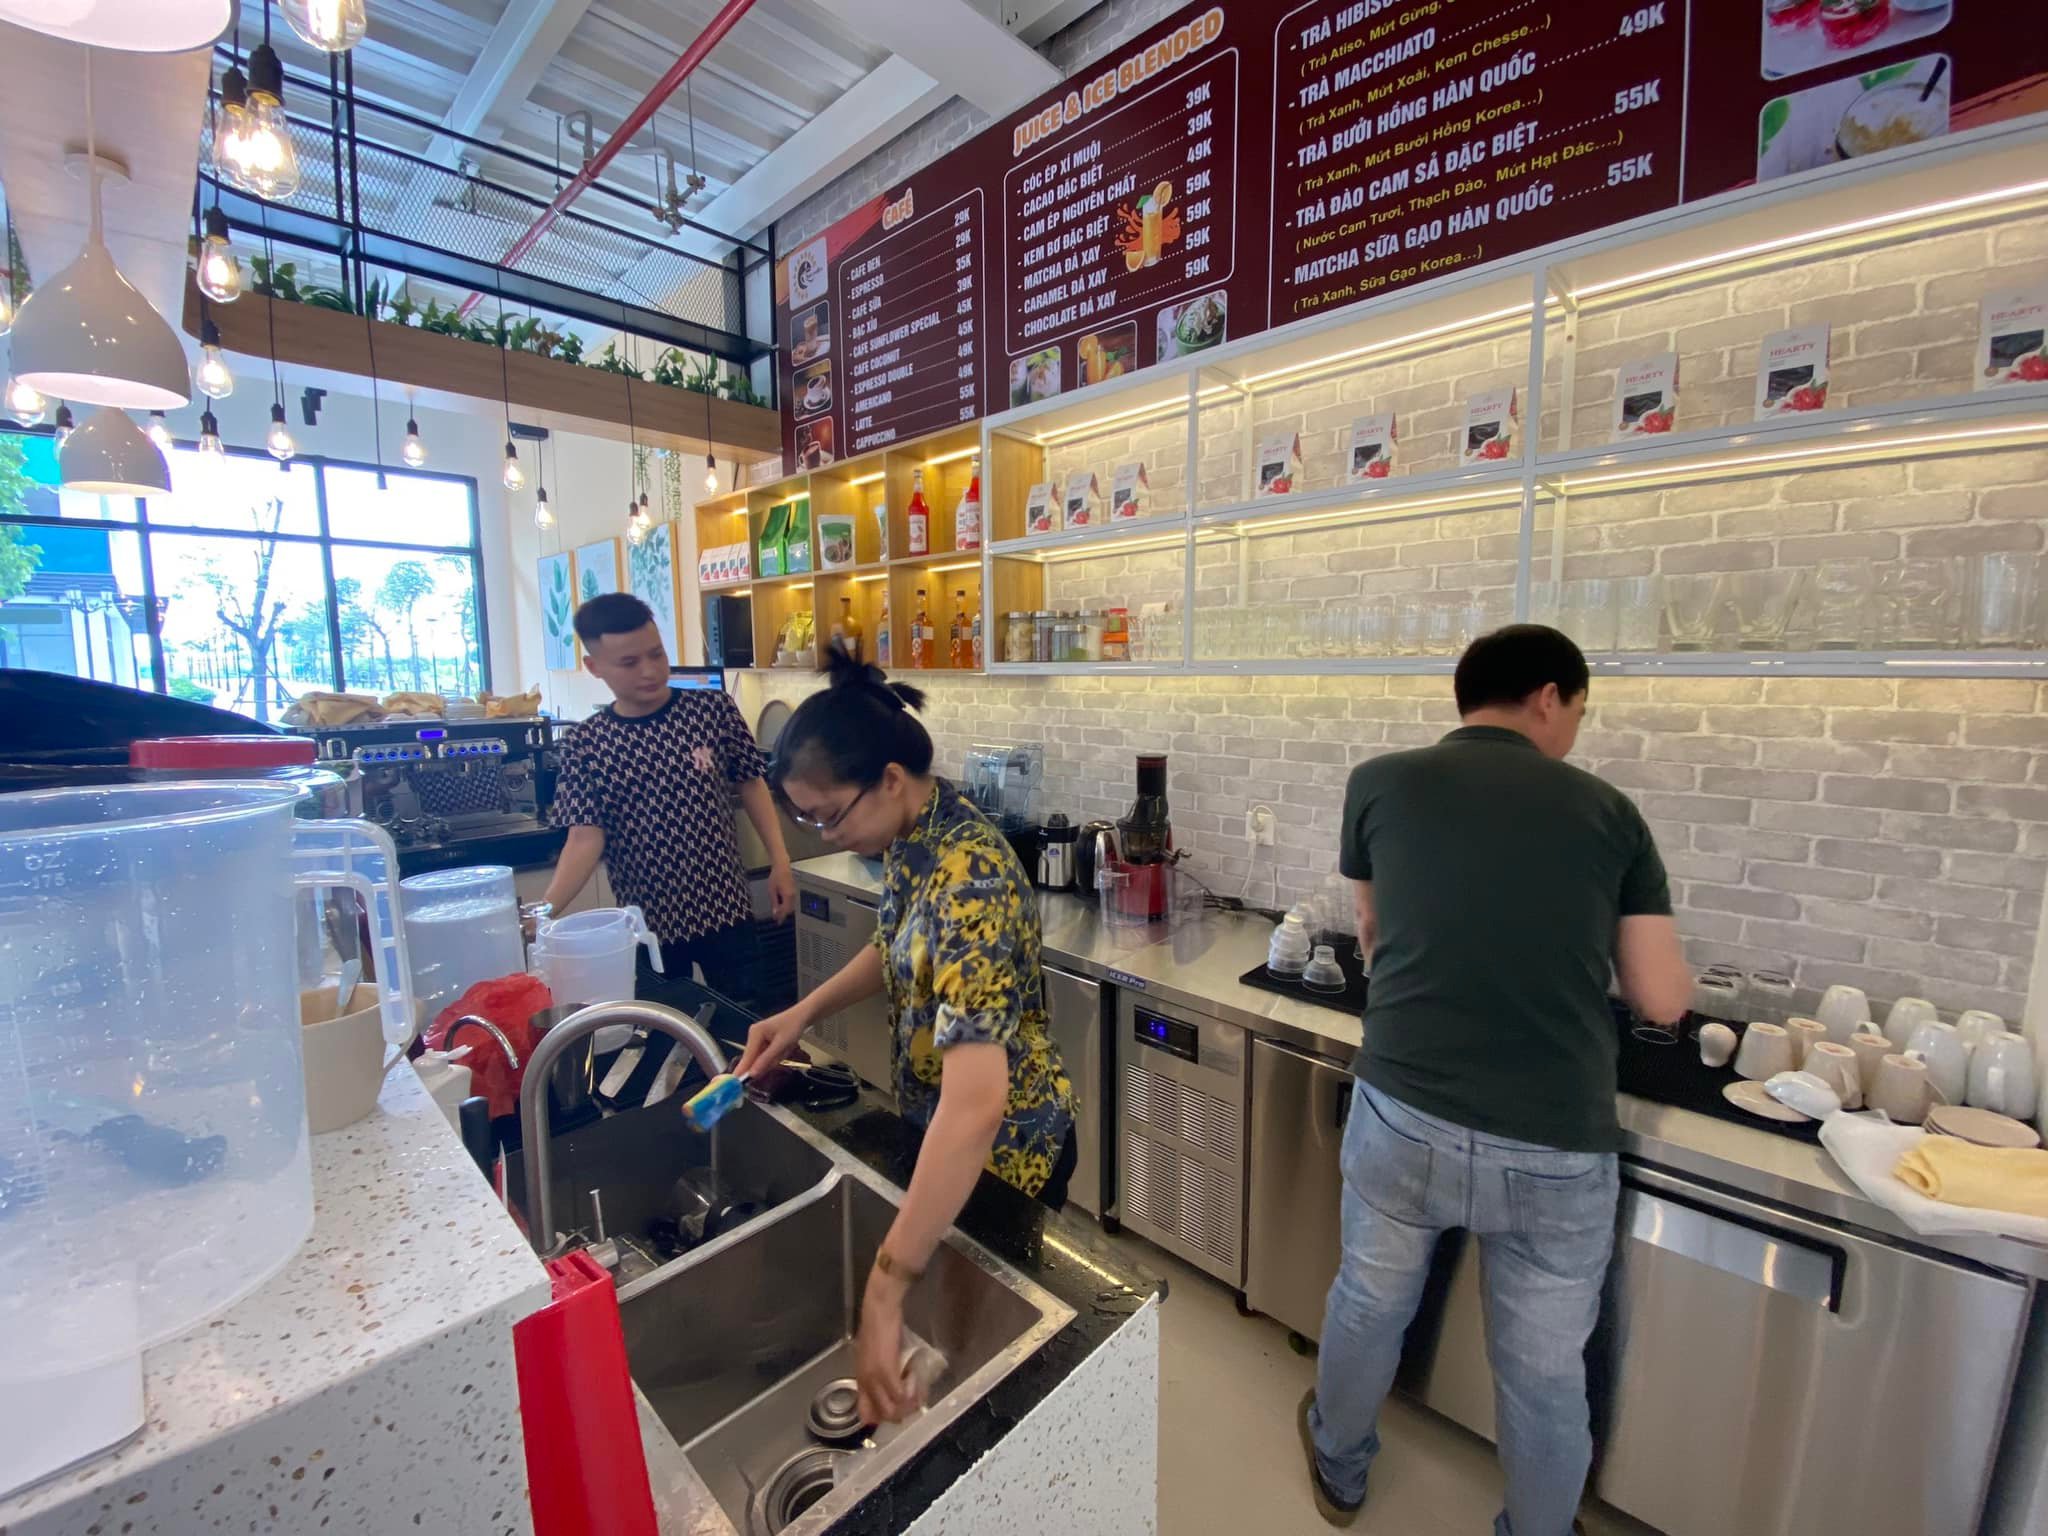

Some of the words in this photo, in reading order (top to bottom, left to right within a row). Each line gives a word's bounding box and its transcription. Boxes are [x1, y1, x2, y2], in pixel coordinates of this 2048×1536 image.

[1301, 16, 1331, 50] TRÀ
[1330, 38, 1366, 60] Atiso,
[1369, 19, 1395, 41] Mứt
[1013, 101, 1063, 158] JUICE
[1064, 91, 1082, 124] &
[1082, 69, 1117, 114] ICE
[1118, 6, 1225, 93] BLENDED
[1298, 136, 1327, 168] TRÀ
[1332, 117, 1372, 154] BƯỞI
[1377, 96, 1427, 135] HỒNG
[1433, 76, 1474, 112] HÀN
[1479, 49, 1536, 93] QUỐC
[1618, 1, 1665, 37] 49K
[1299, 75, 1329, 108] TRÀ
[1334, 27, 1436, 92] MACCHIATO
[1328, 98, 1364, 121] Xanh,
[1367, 82, 1393, 103] Mứt
[1397, 66, 1430, 90] Xoài,
[1434, 52, 1467, 73] Kem
[1023, 173, 1042, 195] CÓC
[1044, 164, 1058, 186] ÉP
[1073, 140, 1101, 169] MUỘI
[1186, 80, 1211, 110] 39K
[1023, 189, 1054, 217] CACAO
[1057, 177, 1078, 201] ĐẶC
[1080, 163, 1104, 189] BIỆT
[1187, 108, 1213, 137] 39K
[1296, 198, 1326, 228] TRÀ
[1330, 188, 1364, 216] ĐÀO
[1369, 169, 1409, 201] CAM
[1414, 152, 1440, 184] SẢ
[1445, 140, 1486, 173] ĐẶC
[1492, 121, 1539, 157] BIỆT
[1614, 78, 1661, 114] 55K
[1326, 163, 1361, 184] Xanh,
[1365, 147, 1391, 168] Mứt
[1433, 118, 1471, 142] Hồng
[954, 207, 971, 227] 29K
[1023, 218, 1045, 242] CAM
[1047, 210, 1060, 231] ÉP
[1062, 190, 1105, 224] NGUYÊN
[1107, 171, 1137, 202] CHẤT
[1186, 137, 1212, 164] 49K
[1023, 245, 1045, 268] KEM
[1047, 235, 1061, 257] BƠ
[1063, 226, 1083, 250] ĐẶC
[1086, 214, 1110, 238] BIỆT
[1186, 169, 1211, 195] 59K
[1294, 248, 1359, 285] MATCHA
[1364, 233, 1400, 262] SỮA
[1405, 219, 1442, 249] GẠO
[1447, 203, 1490, 236] HÀN
[1495, 179, 1554, 221] QUỐC
[1607, 152, 1653, 187] 55K
[1339, 220, 1366, 238] Cam
[1408, 189, 1450, 211] Thạch
[1454, 177, 1487, 195] Đào,
[1495, 162, 1527, 182] Mứt
[1531, 151, 1558, 171] Hạt
[851, 273, 884, 300] ESPRESSO
[955, 228, 971, 248] 29K
[956, 252, 972, 272] 35K
[1024, 261, 1062, 291] MATCHA
[1081, 244, 1101, 267] XAY
[1186, 198, 1211, 223] 59K
[1024, 284, 1069, 314] CARAMEL
[1088, 267, 1108, 290] XAY
[1185, 226, 1210, 251] 59K
[957, 274, 973, 293] 39K
[1024, 305, 1077, 337] CHOCOLATE
[1097, 290, 1117, 312] XAY
[1185, 254, 1210, 279] 59K
[1322, 284, 1356, 304] Xanh,
[1359, 275, 1386, 291] Sữa
[1390, 265, 1417, 282] Gạo
[870, 324, 909, 352] SUNFLOWER
[910, 311, 941, 335] SPECIAL
[957, 297, 973, 315] 45K
[958, 319, 974, 336] 45K
[1769, 342, 1816, 358] HEARTY
[854, 373, 887, 396] ESPRESSO
[888, 363, 914, 383] DOUBLE
[958, 341, 973, 358] 49K
[855, 391, 892, 414] AMERICANO
[958, 362, 974, 379] 49K
[1625, 370, 1665, 385] HEARTY
[855, 415, 873, 431] LATTE
[960, 383, 975, 400] 55K
[856, 428, 897, 450] CAPPUCCINO
[960, 404, 975, 421] 55K
